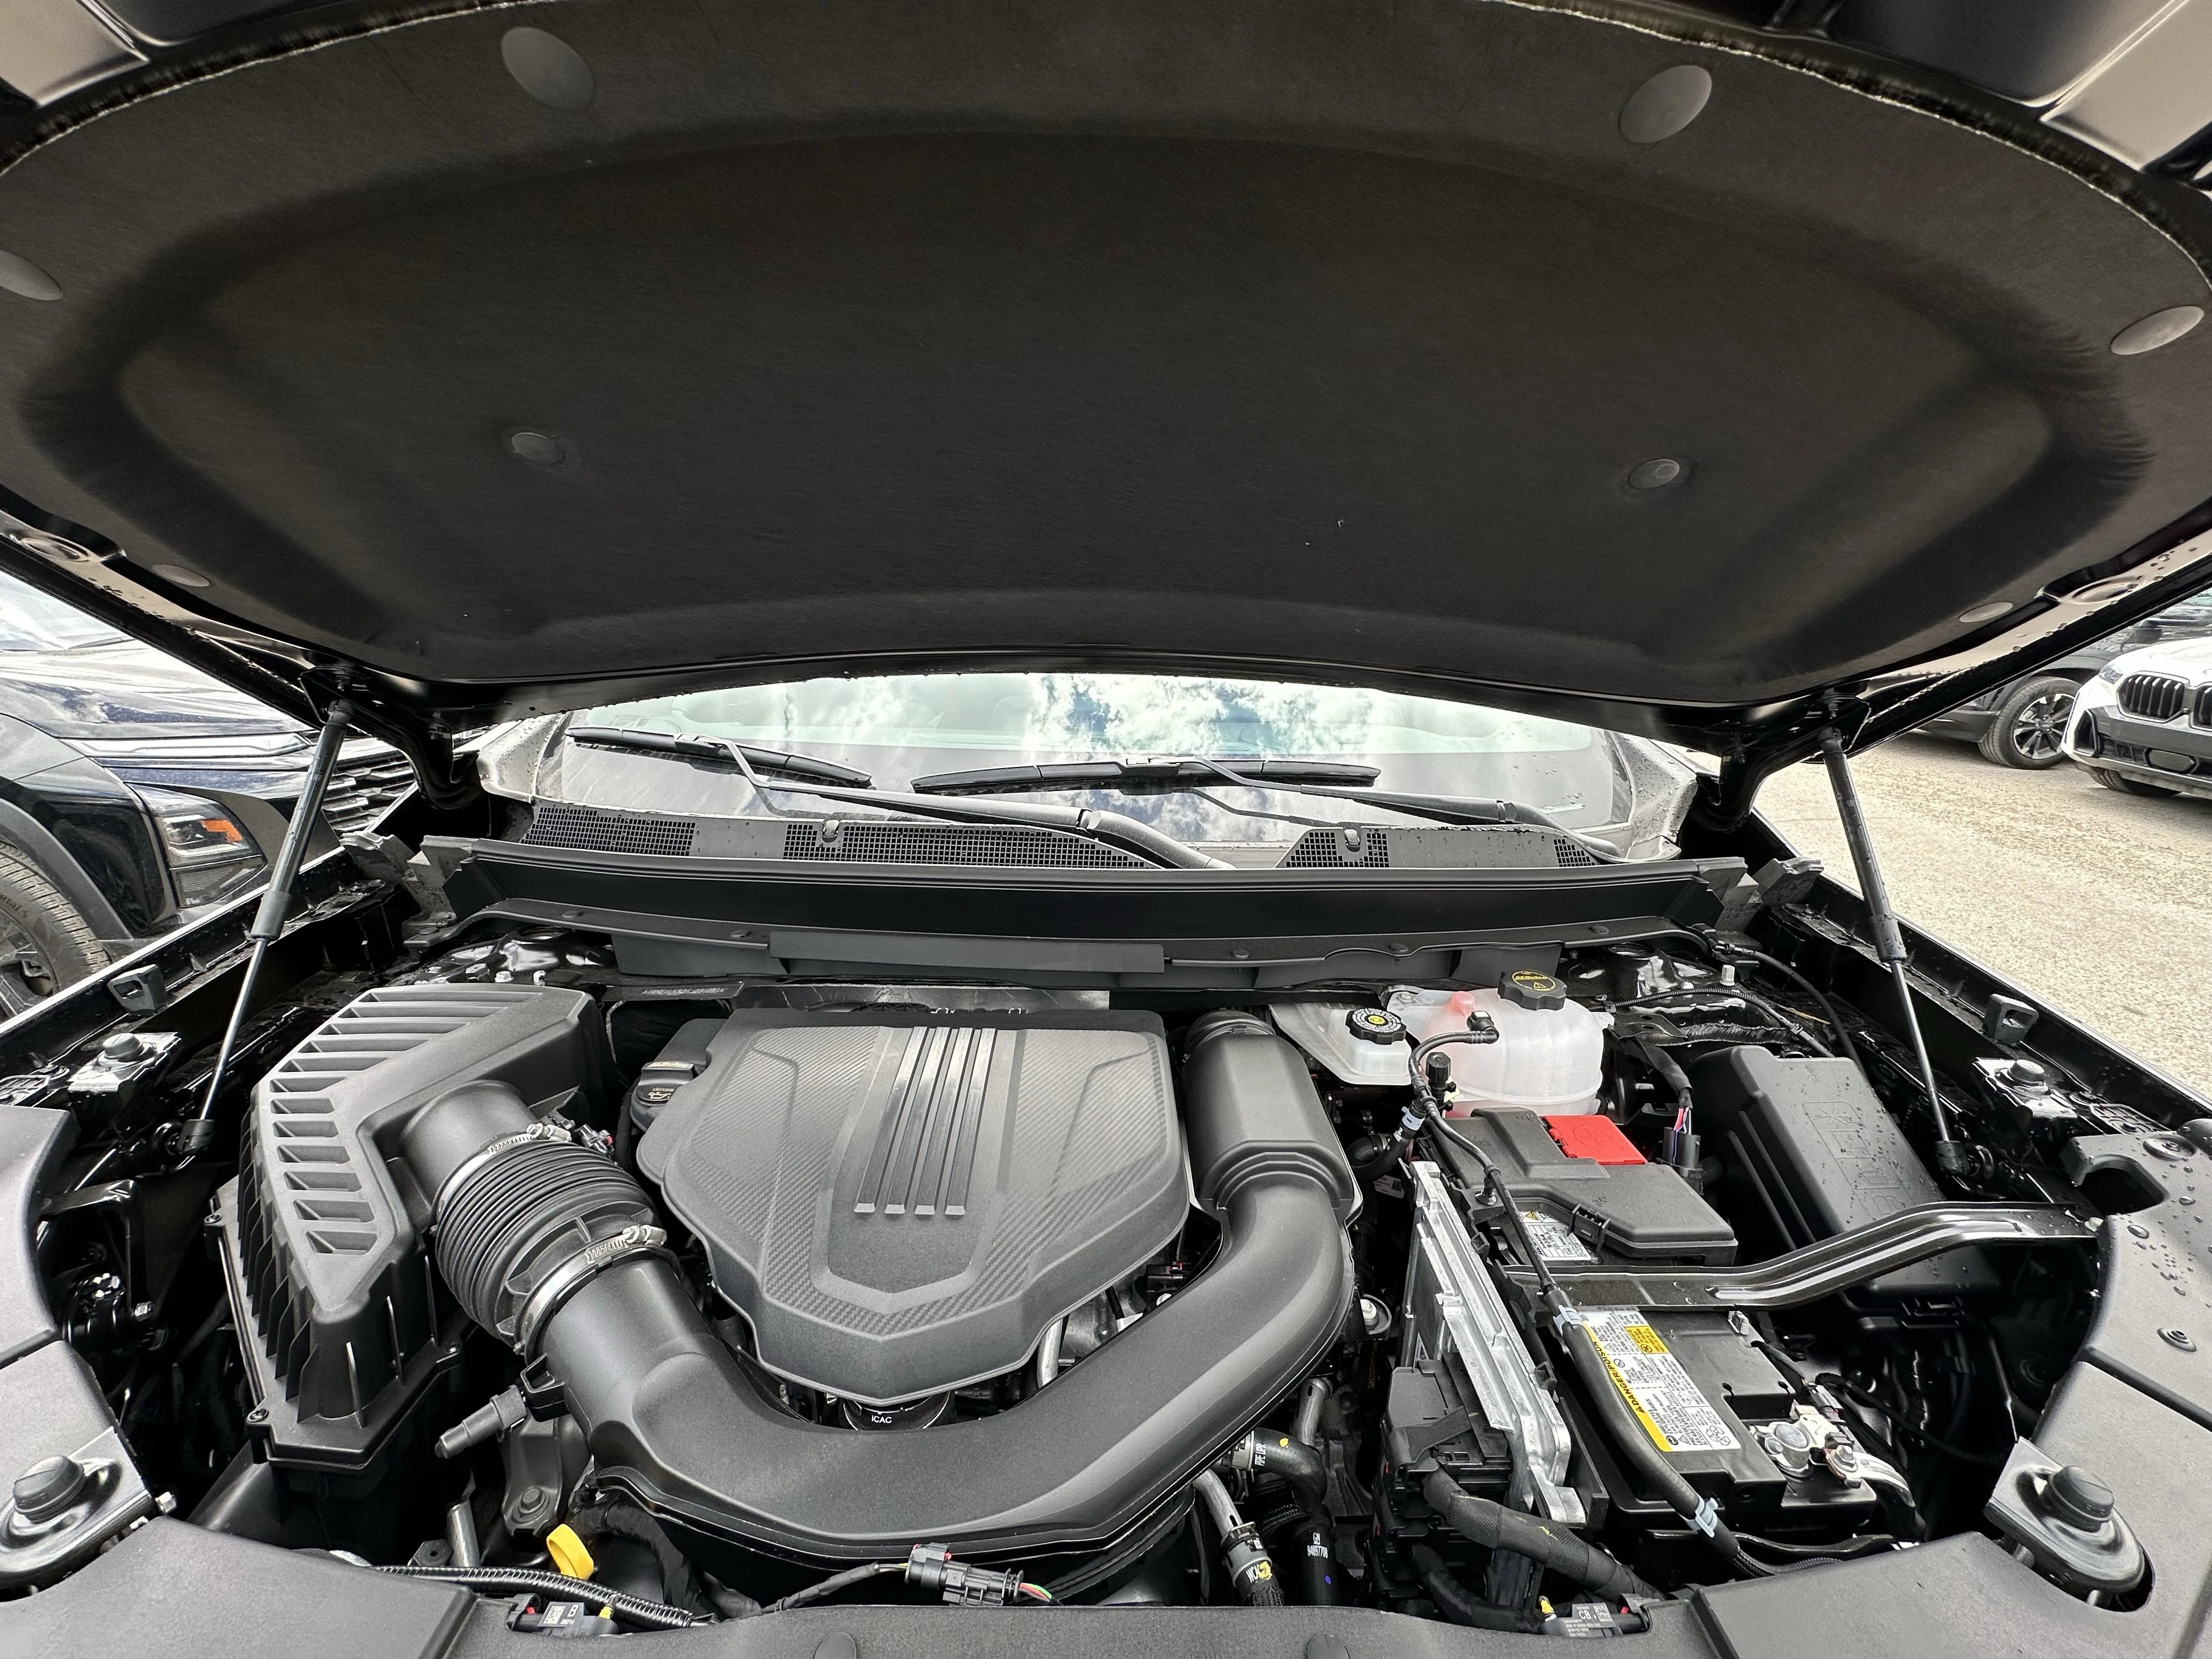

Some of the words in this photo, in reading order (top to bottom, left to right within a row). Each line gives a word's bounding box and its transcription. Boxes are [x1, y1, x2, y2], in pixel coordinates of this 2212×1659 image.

[871, 1415, 892, 1424] ICAC
[567, 1604, 579, 1617] B
[1578, 1610, 1592, 1620] CB
